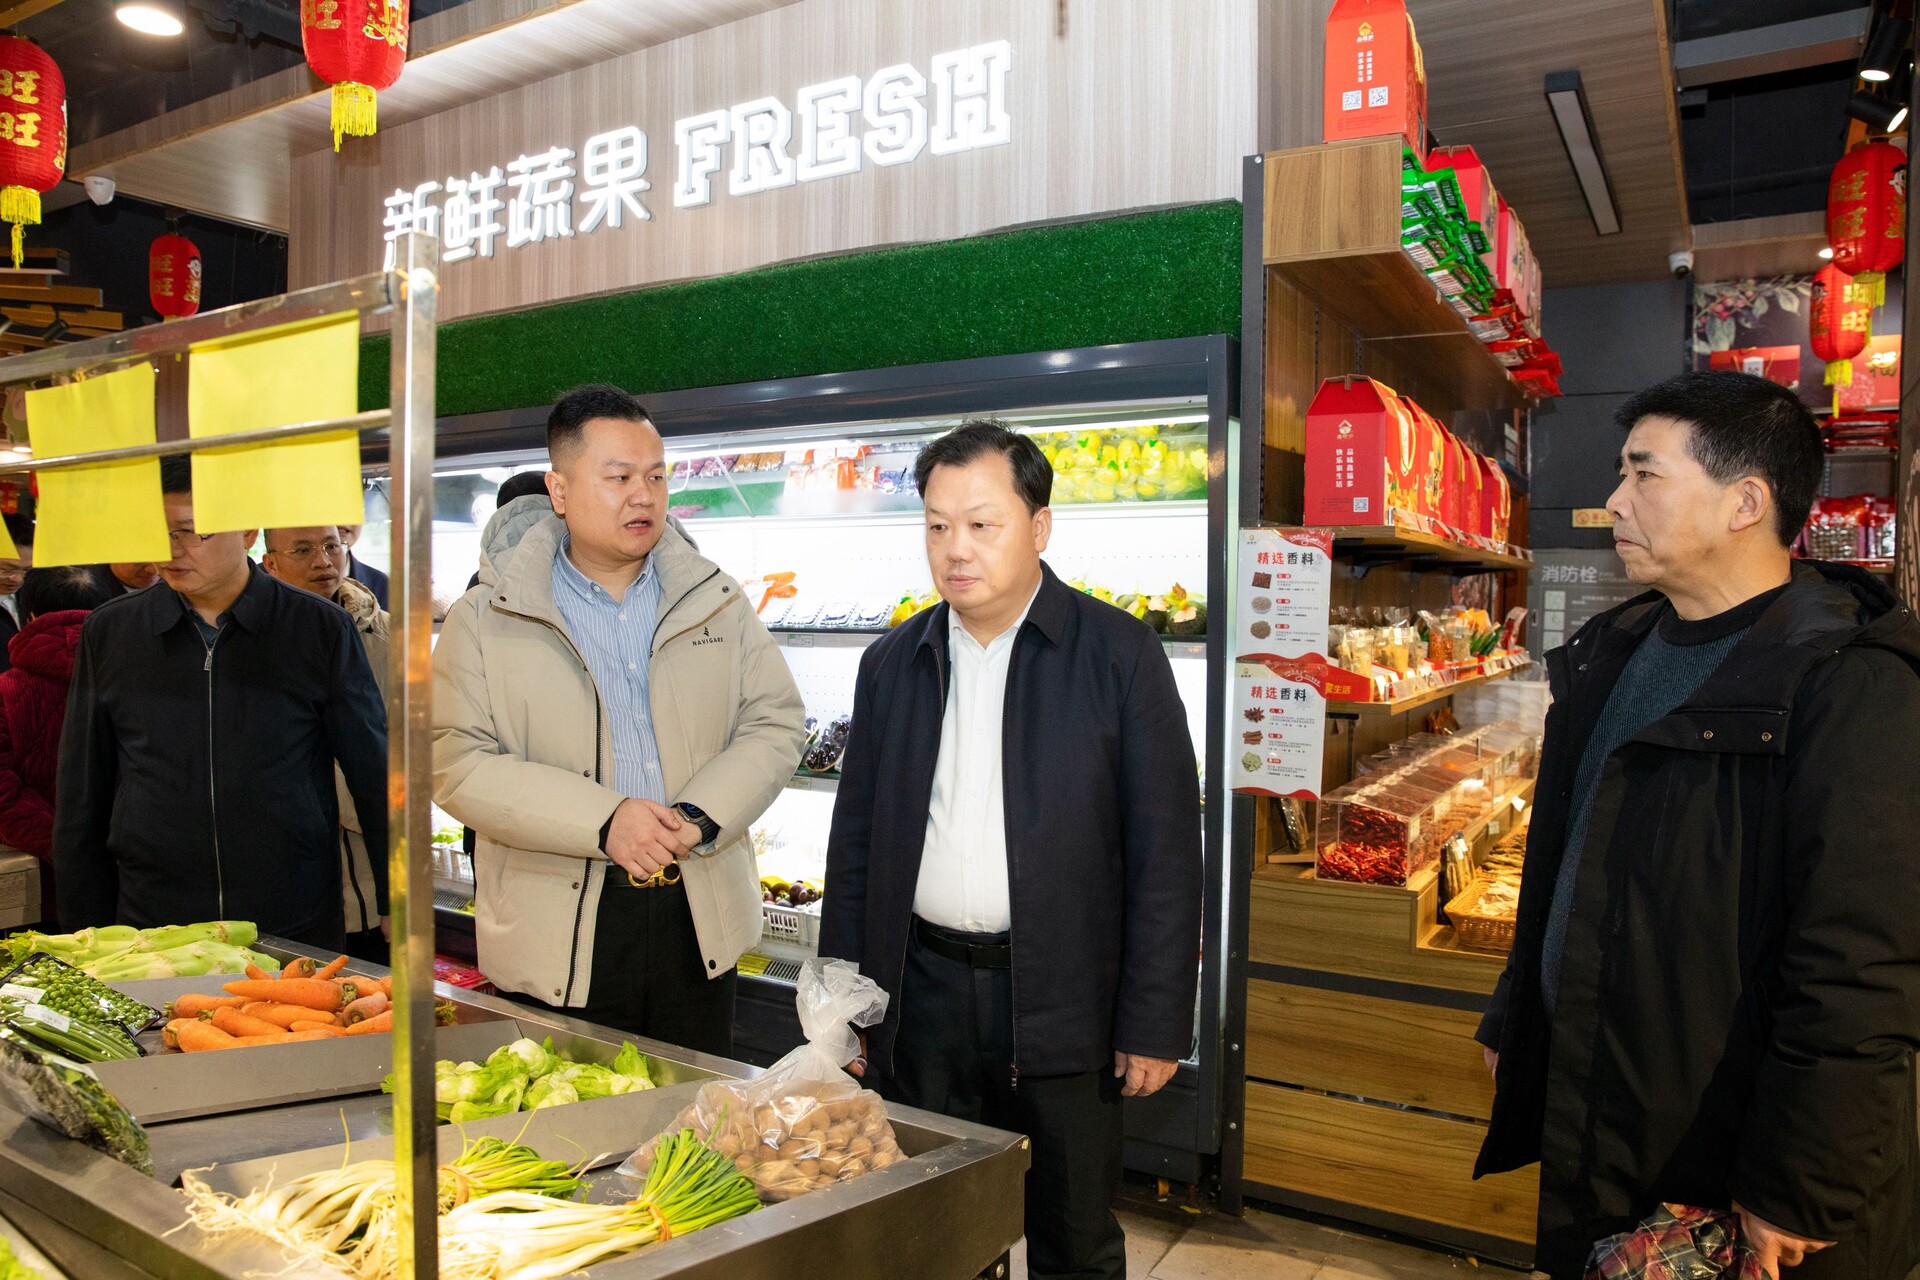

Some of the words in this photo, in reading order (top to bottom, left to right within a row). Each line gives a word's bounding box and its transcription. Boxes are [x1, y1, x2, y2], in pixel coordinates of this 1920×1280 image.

[383, 125, 650, 272] 新鲜蔬果
[674, 39, 1012, 208] FRESH
[1257, 551, 1314, 565] 精选香料
[1542, 565, 1597, 583] 消防栓
[1251, 685, 1306, 702] 精选香料
